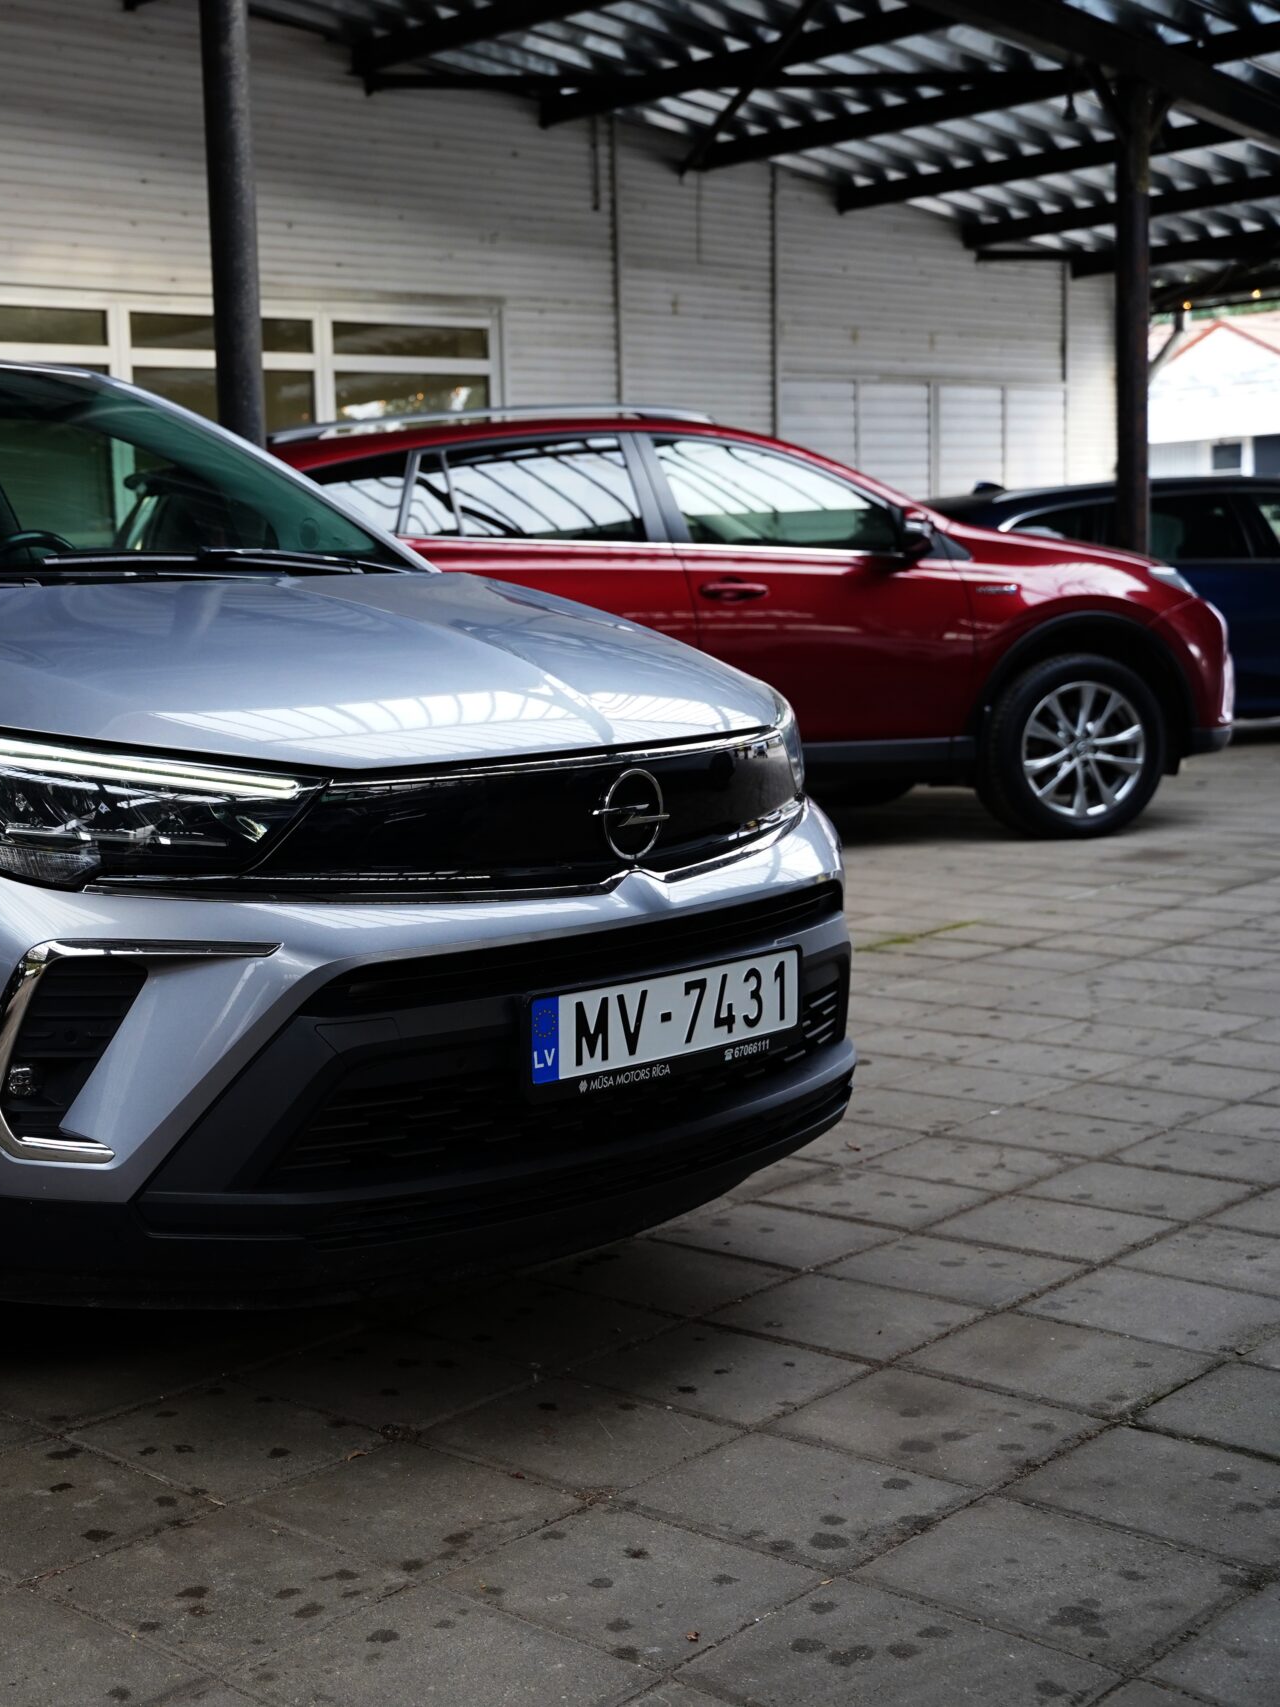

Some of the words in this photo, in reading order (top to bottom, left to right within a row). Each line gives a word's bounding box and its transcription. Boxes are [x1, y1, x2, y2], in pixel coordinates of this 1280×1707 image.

[575, 960, 785, 1067] MV-7431
[533, 1048, 555, 1068] LV
[734, 1039, 770, 1058] 67066111
[589, 1075, 614, 1091] MŪSA
[616, 1067, 650, 1085] MOTORS
[652, 1063, 671, 1078] RĪGA
